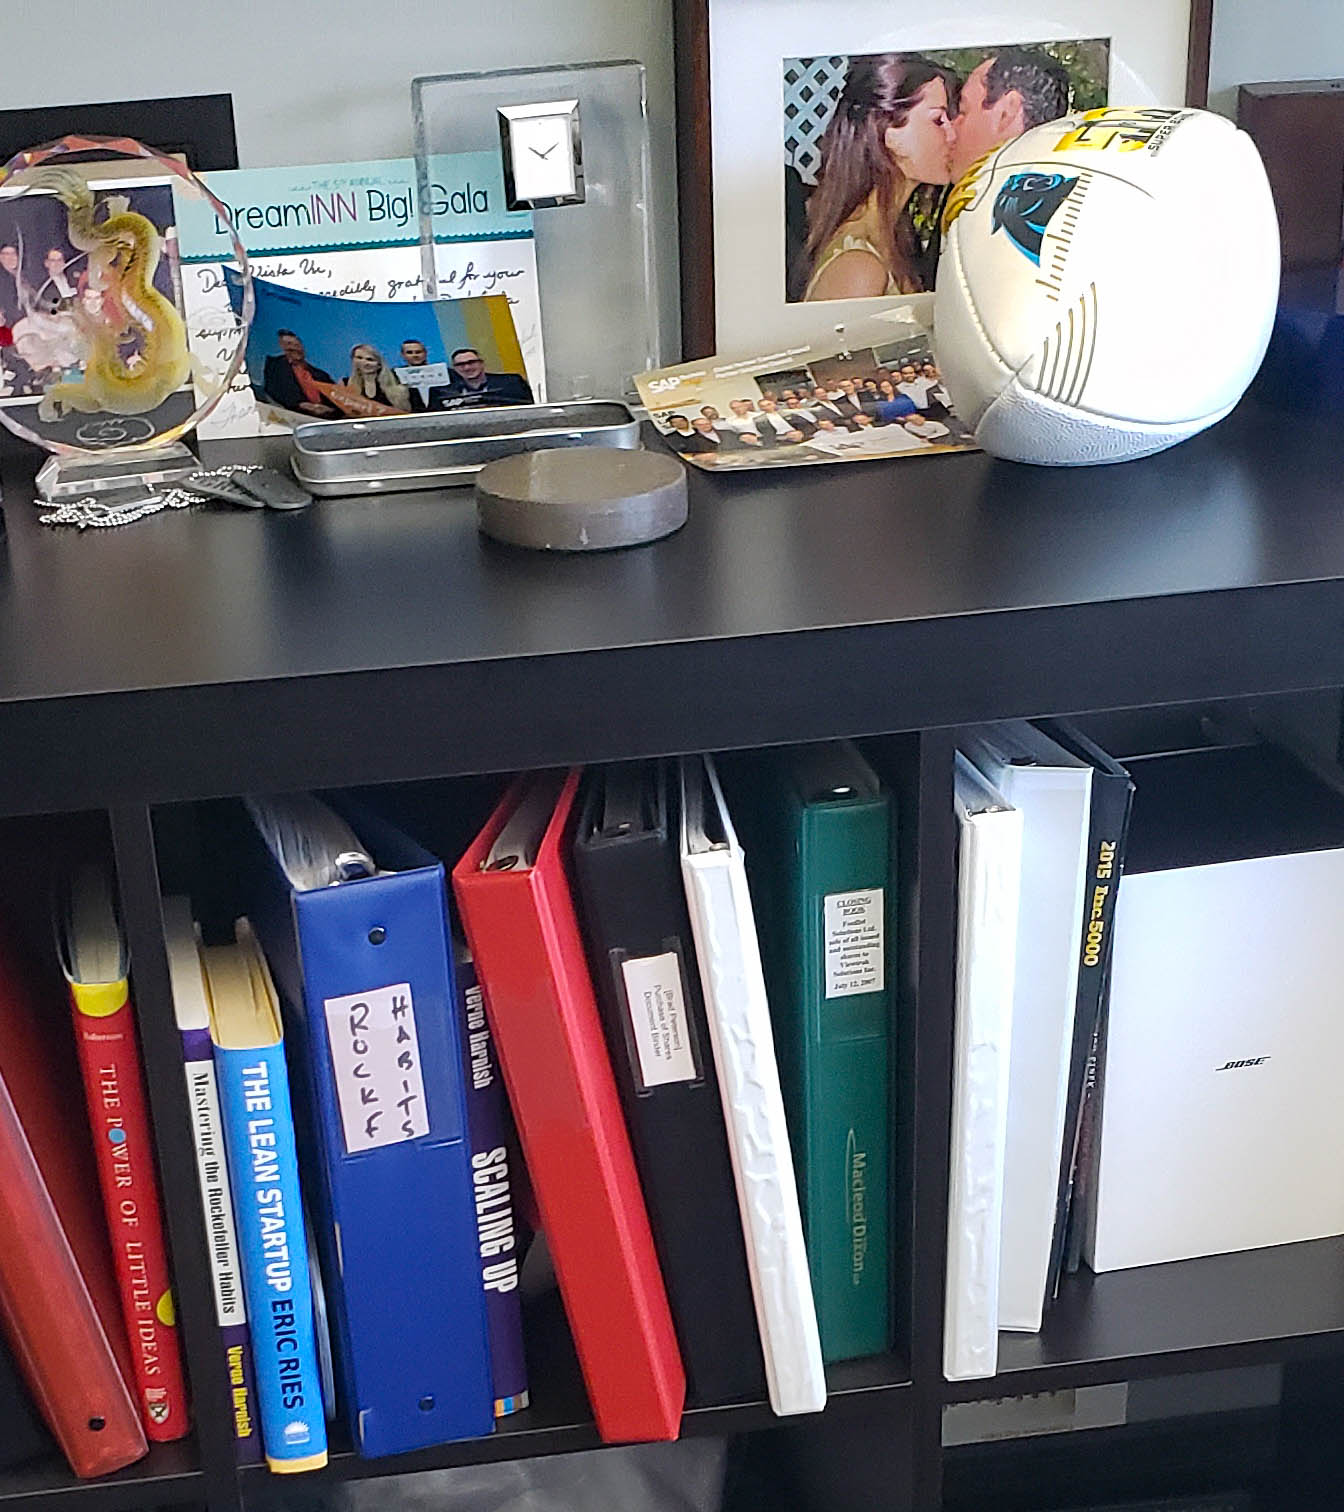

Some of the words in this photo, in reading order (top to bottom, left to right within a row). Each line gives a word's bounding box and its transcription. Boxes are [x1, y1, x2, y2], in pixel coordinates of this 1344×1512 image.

[367, 187, 415, 227] Big!
[420, 183, 488, 217] Gala
[483, 268, 525, 289] your
[648, 376, 681, 393] SAP
[1096, 840, 1116, 879] 2015
[465, 985, 485, 1030] Verne
[469, 1030, 494, 1090] Harnish
[1216, 1056, 1271, 1071] BOSE
[99, 1063, 121, 1109] THE
[242, 1061, 272, 1113] THE
[193, 1072, 216, 1157] Mastering
[205, 1161, 220, 1183] the
[248, 1118, 281, 1183] LEAN
[119, 1199, 139, 1228] OF
[471, 1146, 516, 1258] SCALING
[208, 1187, 231, 1267] Rockefeller
[256, 1188, 293, 1293] STARTUP
[125, 1241, 152, 1312] LITTLE
[219, 1271, 235, 1315] Habits
[482, 1257, 519, 1293] UP
[137, 1319, 161, 1376] IDEAS
[272, 1299, 298, 1353] ERIC
[227, 1345, 245, 1385] Verne
[278, 1357, 305, 1410] RIES
[233, 1387, 254, 1438] Harnish
